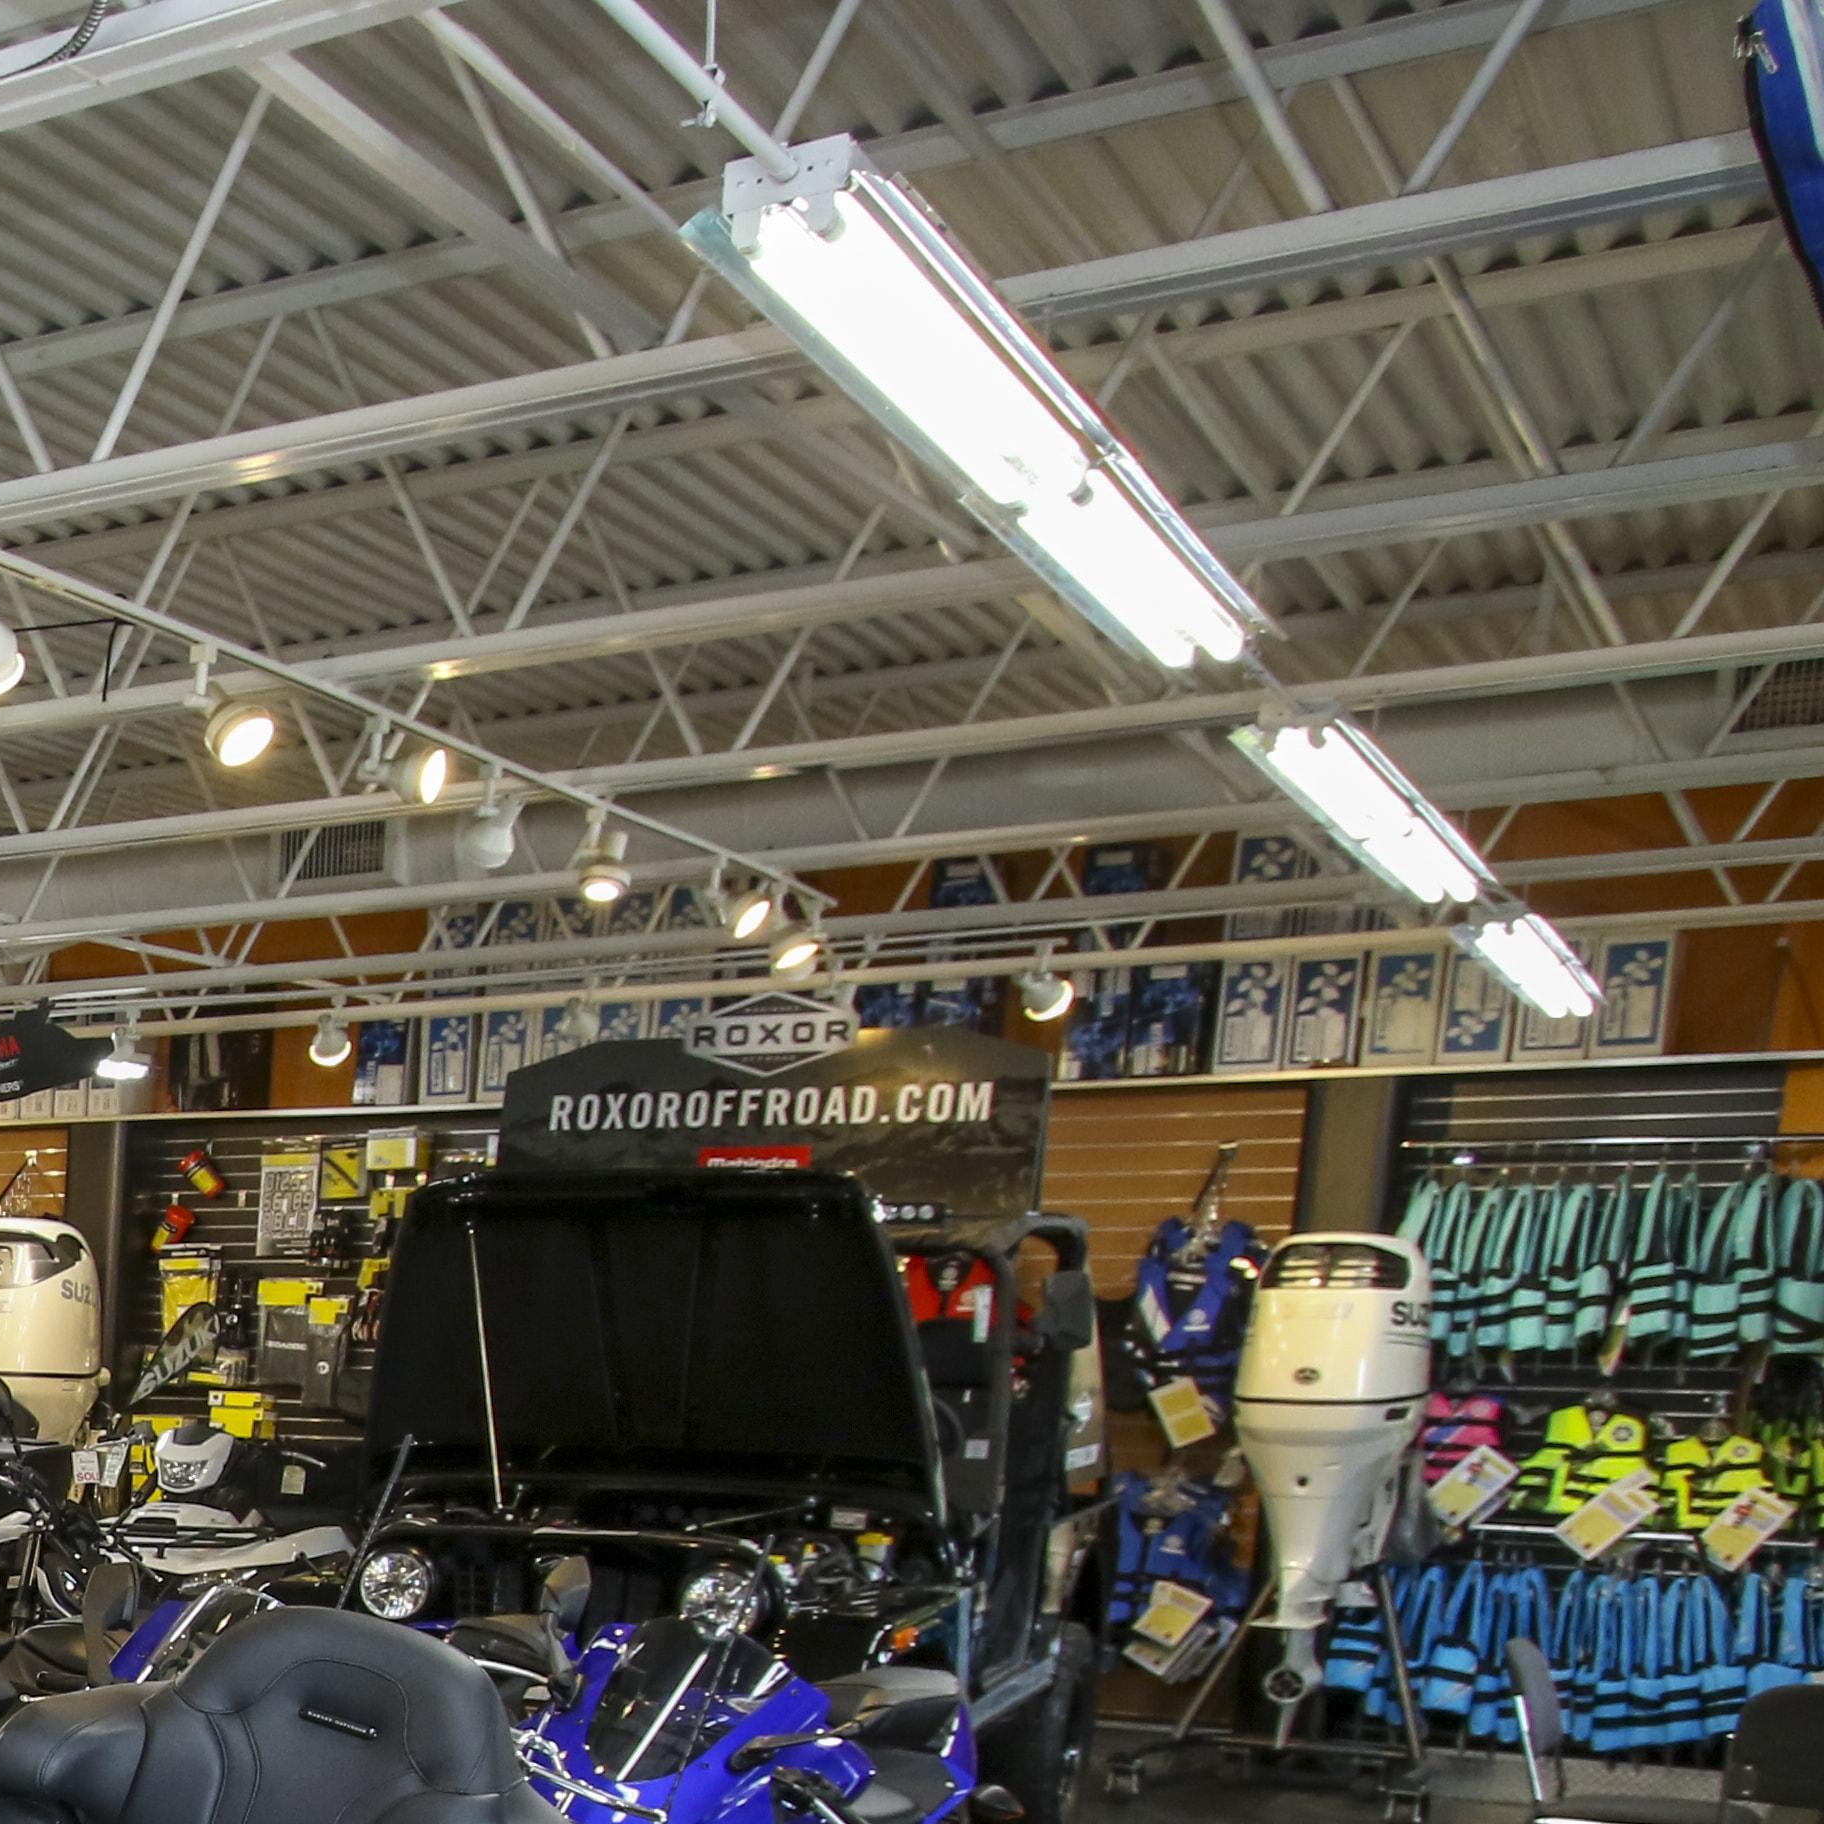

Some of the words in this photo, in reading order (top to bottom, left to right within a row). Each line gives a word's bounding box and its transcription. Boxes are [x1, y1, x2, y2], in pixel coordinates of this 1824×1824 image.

[692, 1020, 850, 1048] ROXOR
[548, 1081, 995, 1132] ROXOROFFROAD.COM
[76, 1471, 100, 1482] SOL
